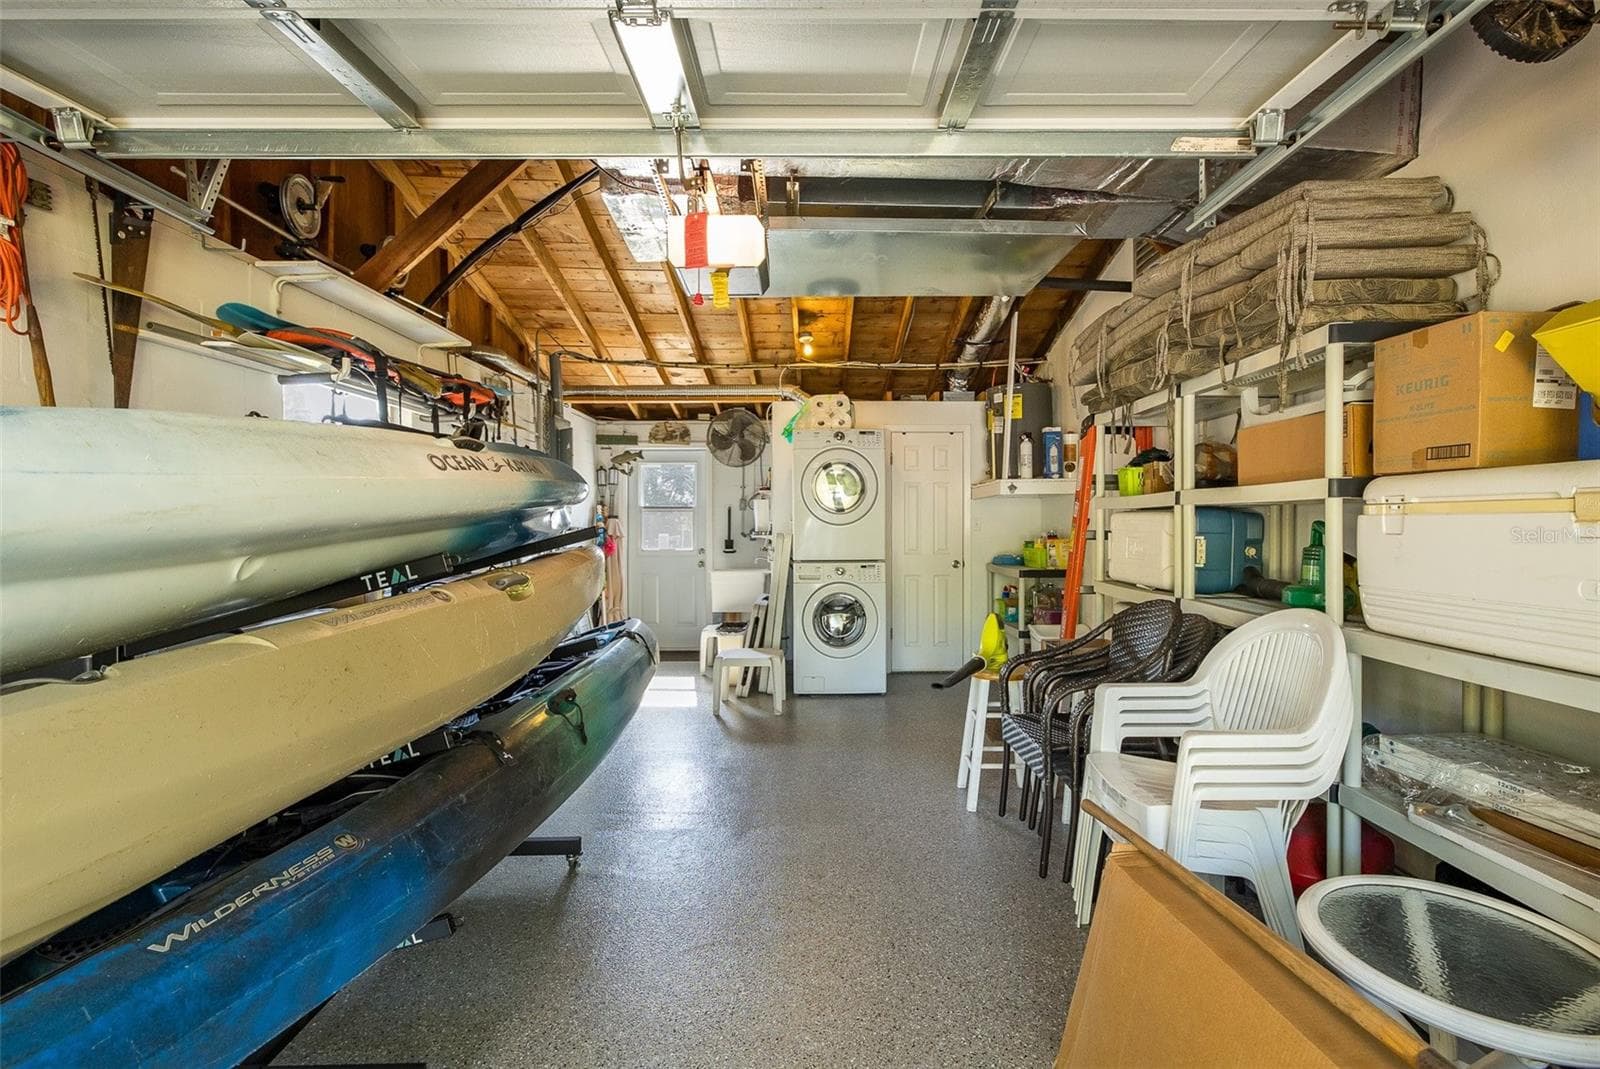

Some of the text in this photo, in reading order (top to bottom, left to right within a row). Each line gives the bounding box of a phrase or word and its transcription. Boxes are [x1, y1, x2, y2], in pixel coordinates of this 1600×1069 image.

[1396, 375, 1449, 396] KEURIG
[427, 453, 489, 471] OCEAN
[360, 564, 418, 591] TEAL
[280, 853, 337, 888] SYSTEMS
[147, 846, 335, 953] WILDERNESS
